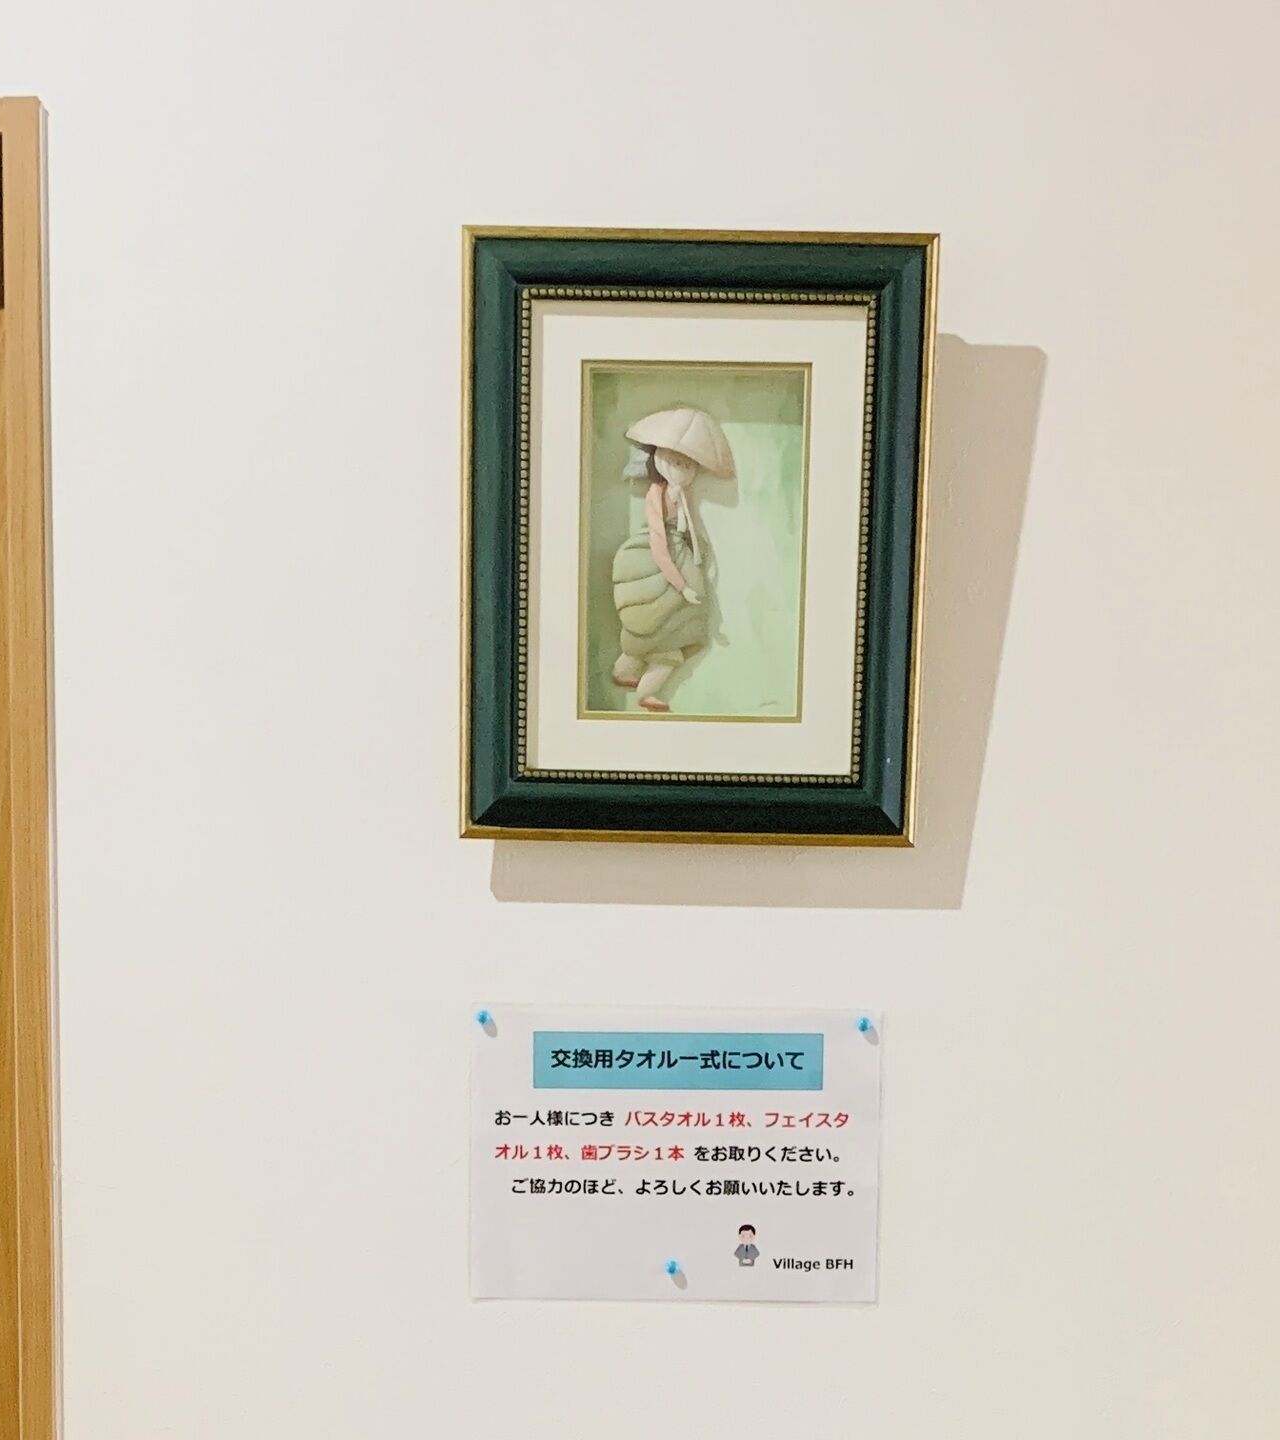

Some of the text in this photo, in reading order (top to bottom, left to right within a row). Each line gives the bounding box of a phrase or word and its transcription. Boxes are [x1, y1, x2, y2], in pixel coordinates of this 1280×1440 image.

[550, 1048, 806, 1071] 交換用タオル一式について
[494, 1110, 615, 1127] お一人様につき
[694, 1145, 841, 1163] をお取りください。
[511, 1178, 855, 1197] ご協力のほど、よろしくお願いいたします。
[773, 1257, 854, 1272] Village BFH
